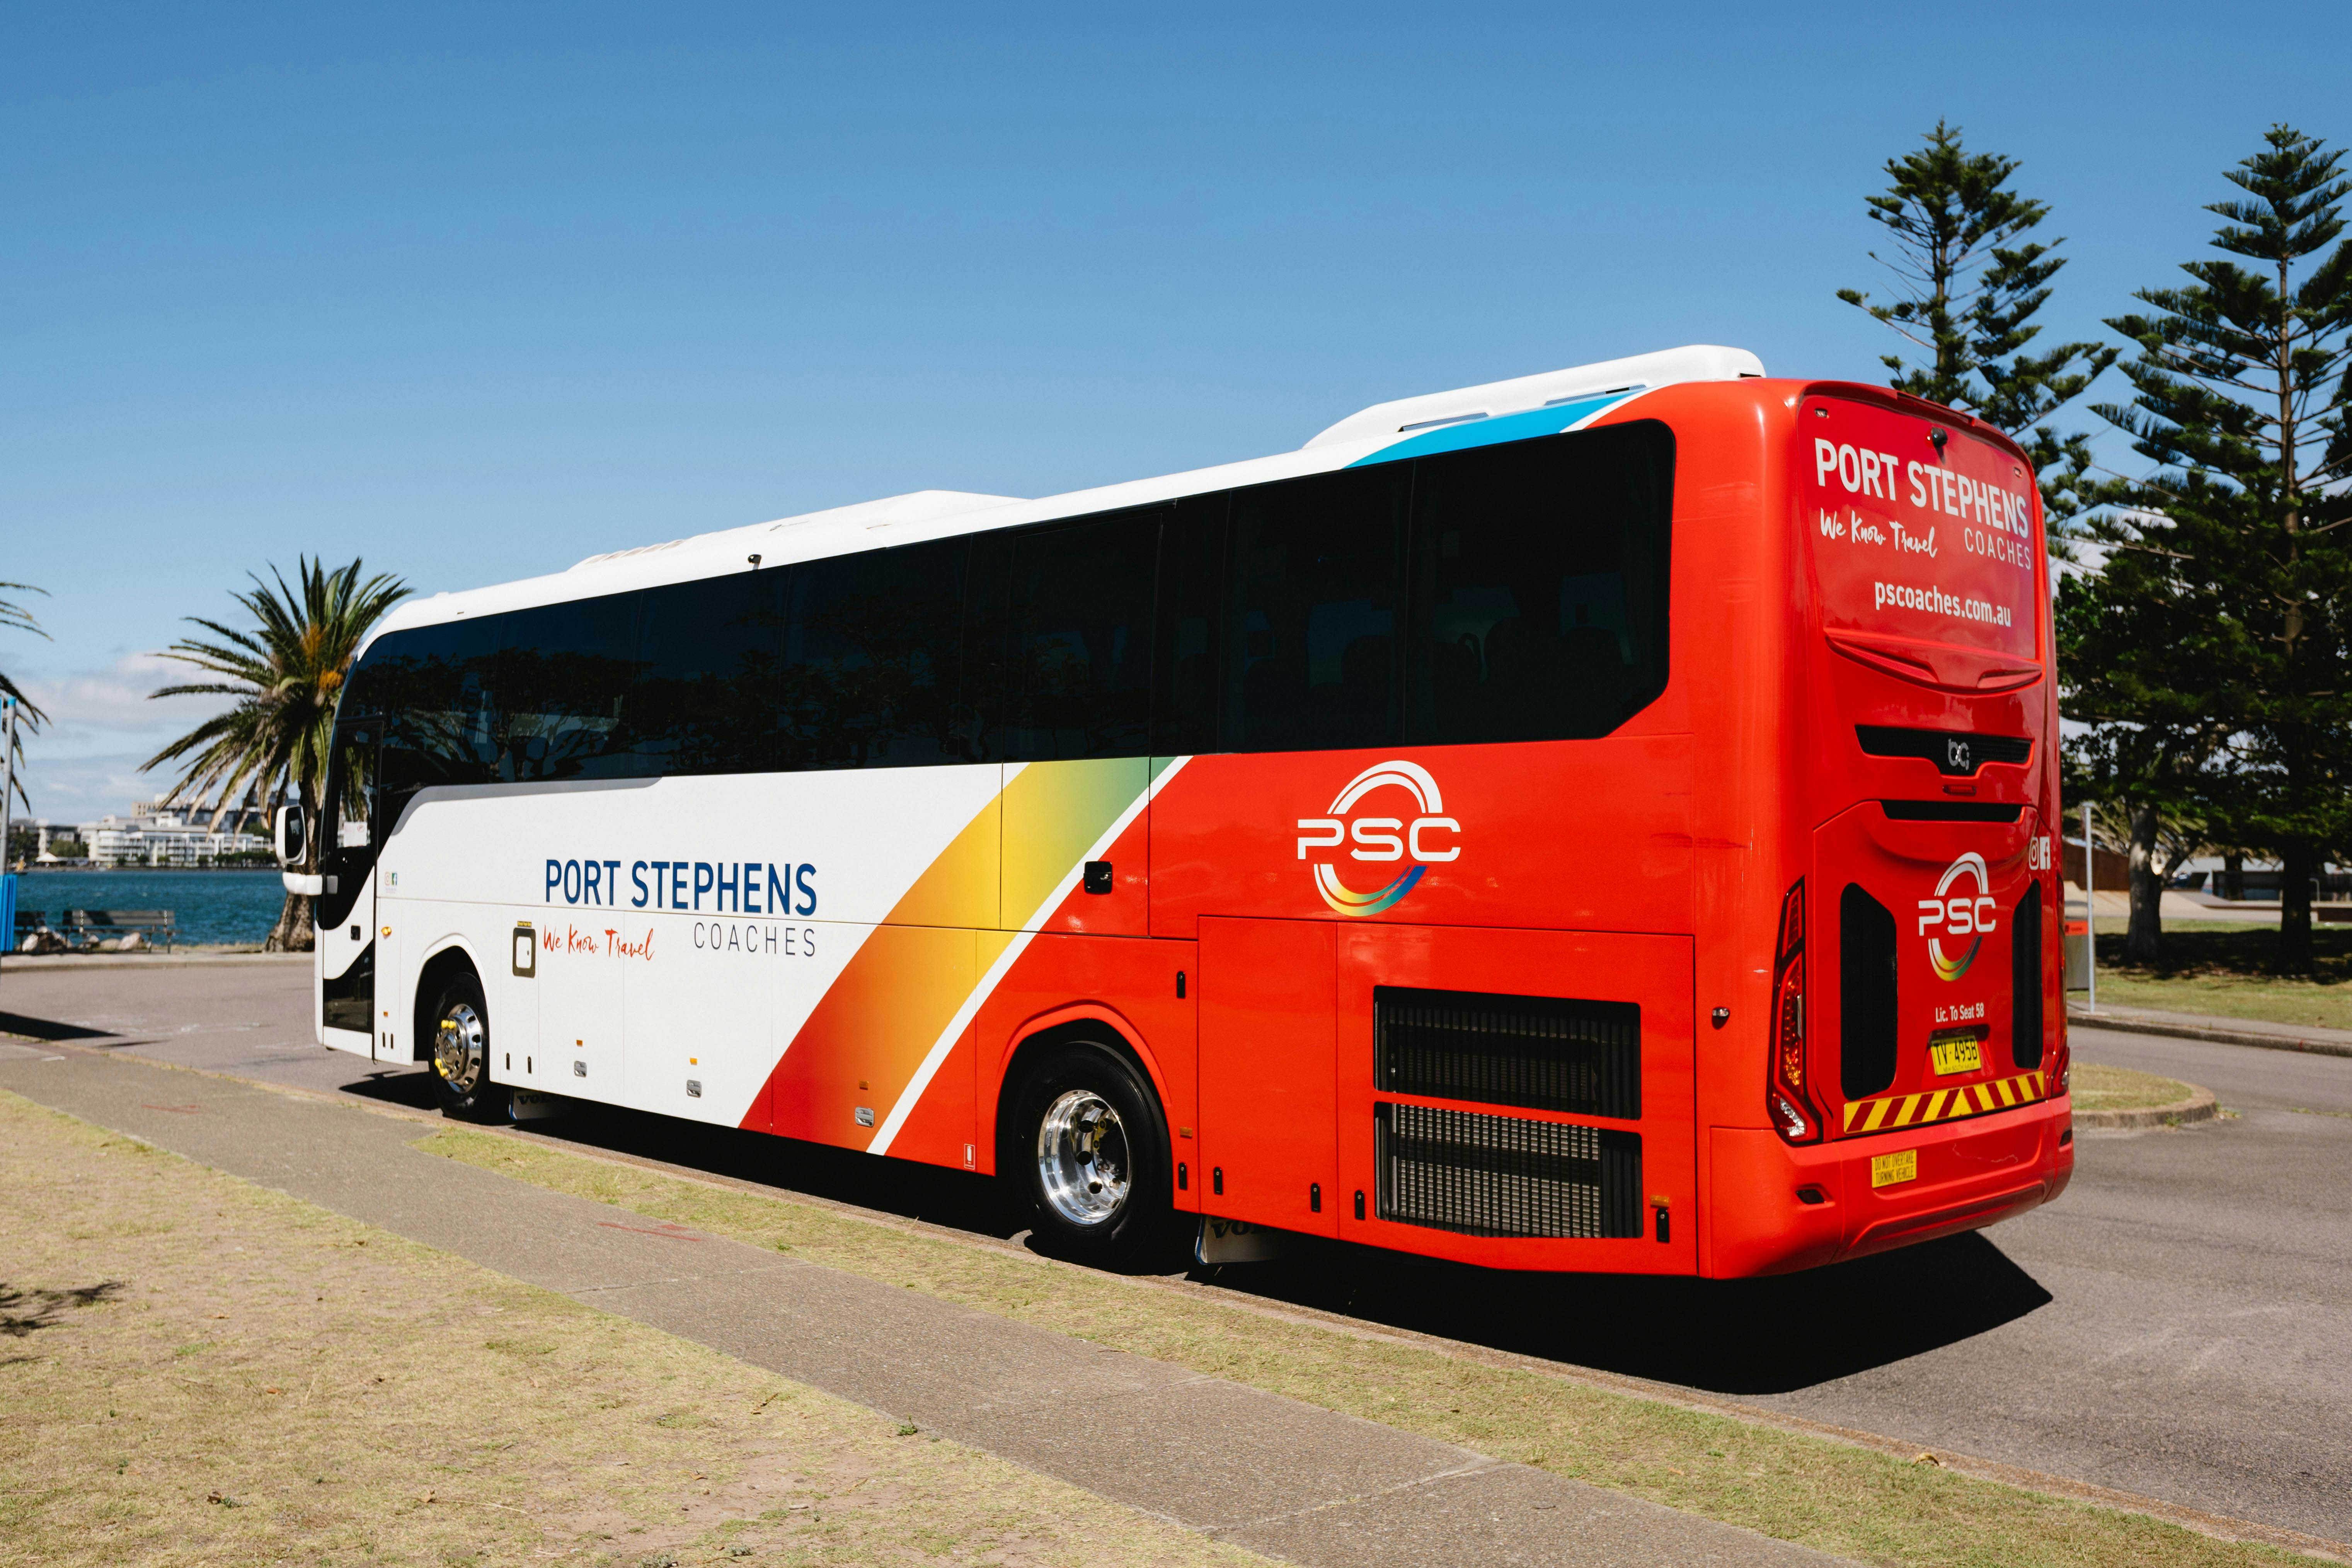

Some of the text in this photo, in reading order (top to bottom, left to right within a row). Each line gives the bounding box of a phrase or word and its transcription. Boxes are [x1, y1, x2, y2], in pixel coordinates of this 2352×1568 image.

[1815, 438, 2028, 539] PORT STEPHENS
[1820, 507, 1938, 558] We Know Travel
[1964, 528, 2031, 570] COACHES
[1875, 582, 2011, 627] pscoaches.com.au
[1298, 817, 1461, 862] PSC
[546, 859, 817, 916] PORT STEPHENS
[1918, 897, 1996, 936] PSC
[543, 924, 654, 961] We Know Travel
[694, 922, 815, 957] COACHES
[1935, 1002, 1984, 1023] Lic. To Seat 58
[1875, 1158, 1881, 1171] DO
[1882, 1156, 1890, 1169] NOT
